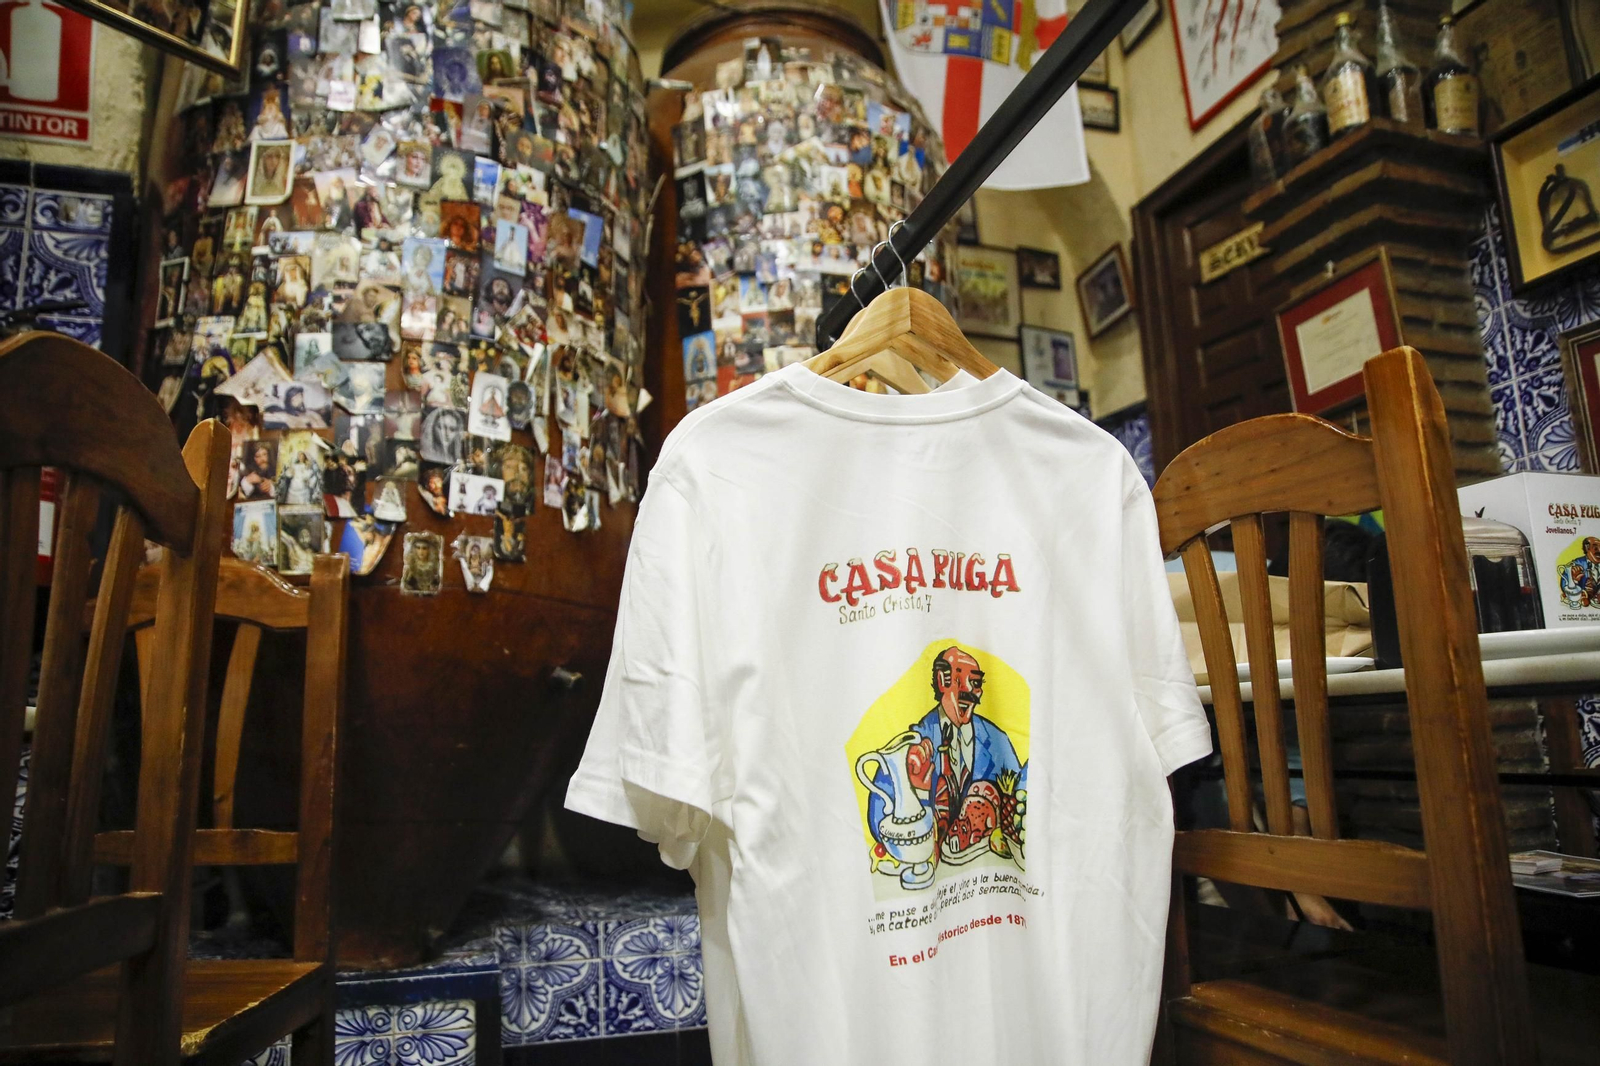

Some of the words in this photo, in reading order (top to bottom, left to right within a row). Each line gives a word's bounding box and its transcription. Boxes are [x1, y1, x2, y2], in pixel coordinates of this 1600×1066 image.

[1548, 502, 1579, 520] CASA
[818, 547, 927, 607] CASA
[931, 548, 1021, 598] PUGA
[838, 602, 877, 625] Santo
[889, 906, 917, 921] puse
[922, 905, 928, 913] a
[949, 882, 957, 894] el
[972, 876, 978, 886] y
[980, 873, 989, 884] la
[993, 872, 1018, 884] buena
[888, 912, 933, 931] catorce
[889, 954, 908, 967] En
[911, 950, 925, 964] el
[969, 914, 1003, 930] desde
